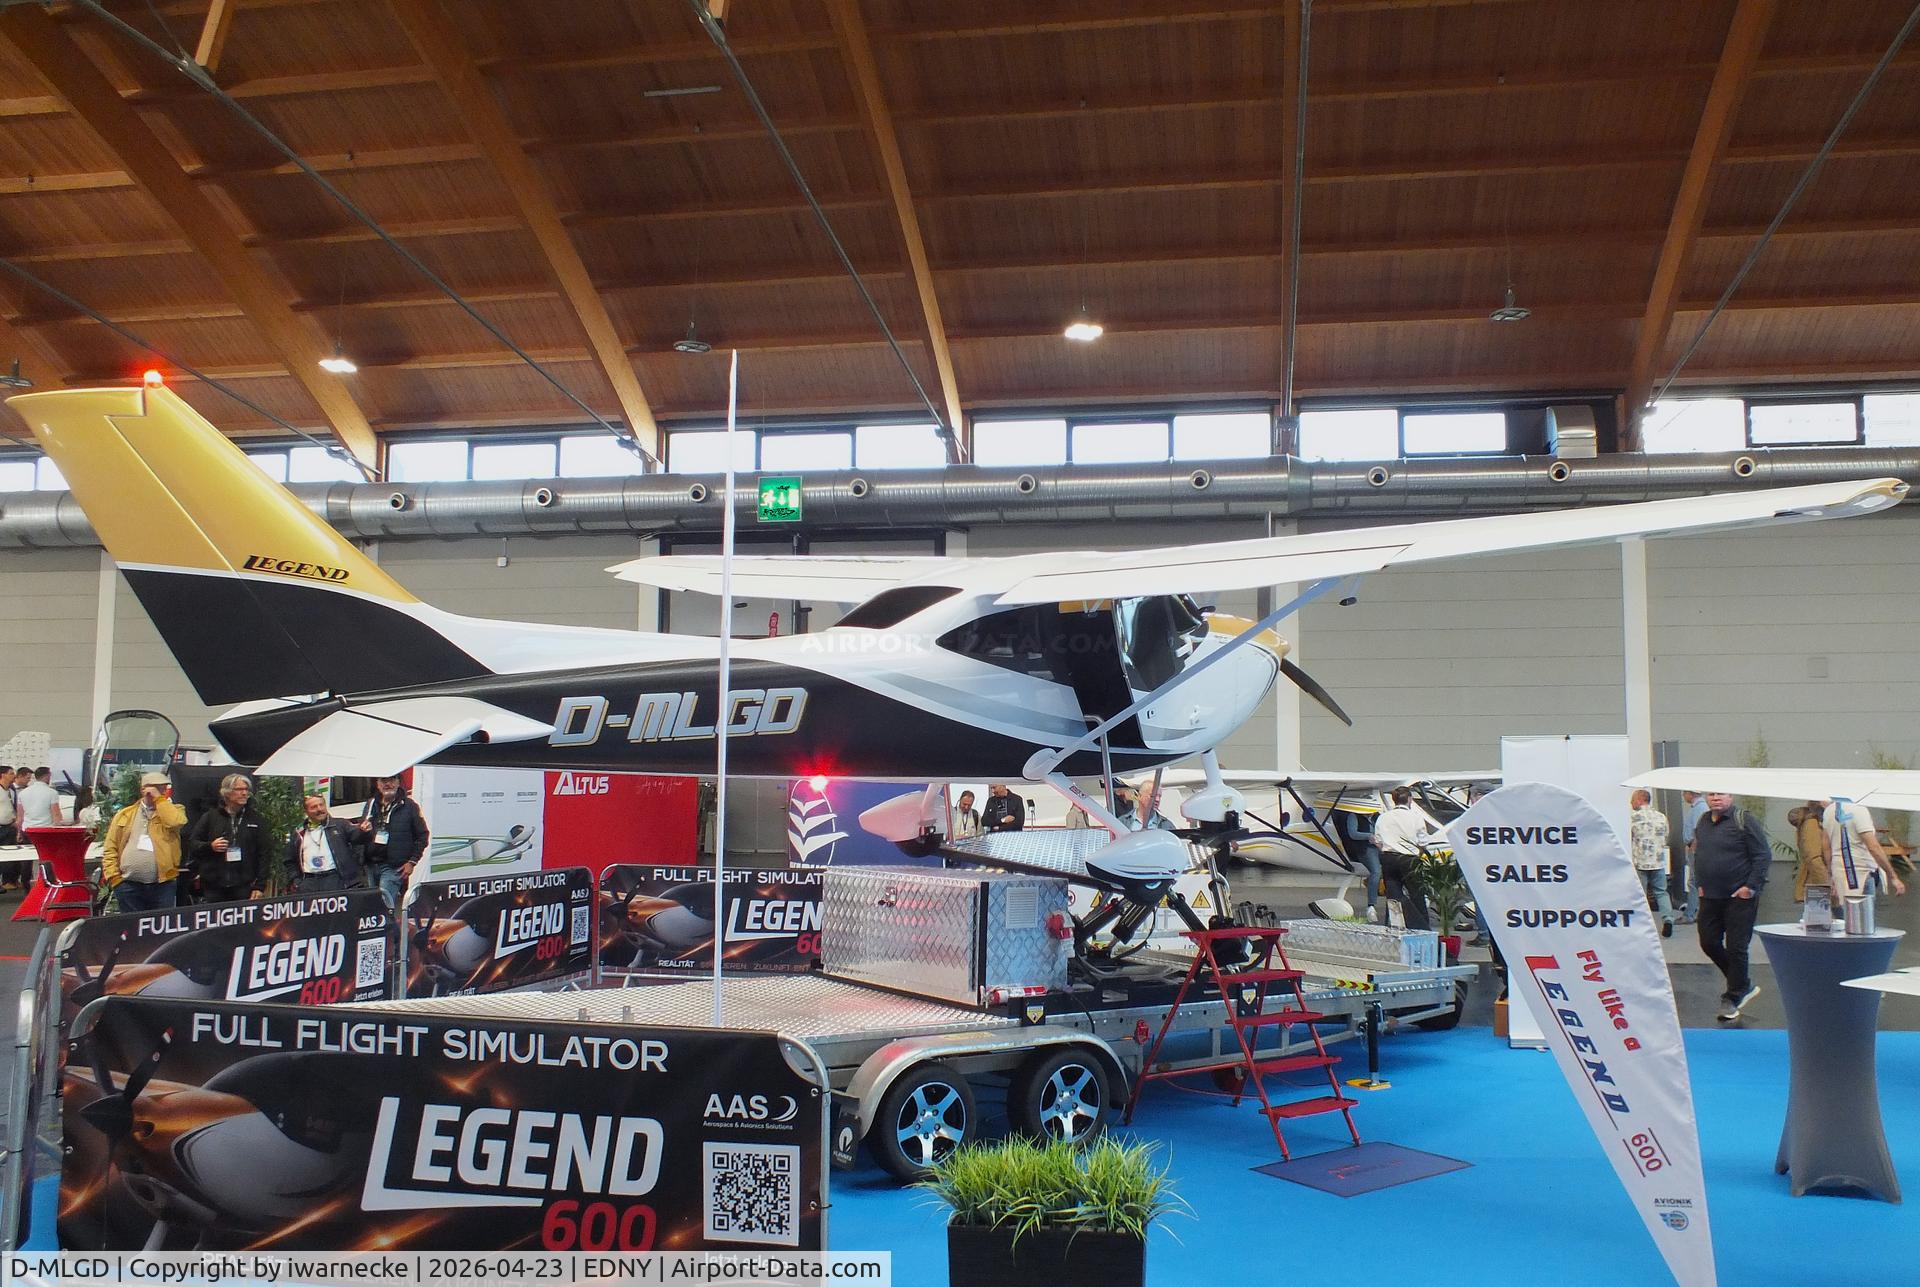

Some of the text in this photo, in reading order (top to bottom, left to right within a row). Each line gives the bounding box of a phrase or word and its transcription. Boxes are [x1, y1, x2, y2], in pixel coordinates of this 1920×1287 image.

[243, 555, 350, 581] LEGEND
[548, 687, 808, 747] D-MLGD
[553, 771, 609, 796] ALTUS
[1466, 826, 1578, 845] SERVICE
[448, 873, 566, 899] FULL FLIGHT SIMULATOR
[654, 869, 823, 885] FULL FLGHT SIMULAT
[1486, 865, 1568, 883] SALES
[138, 896, 348, 936] FULL FLIGHT SIMULATOR
[358, 914, 377, 930] AAS
[724, 898, 824, 942] LEGEN
[1506, 909, 1634, 928] SUPPORT
[494, 902, 565, 959] LEGEND
[796, 933, 822, 954] 60
[536, 936, 564, 960] 600
[225, 933, 346, 1002] LEGEND
[300, 976, 341, 1005] 600
[1576, 949, 1642, 1051] Fly like a
[192, 1012, 669, 1072] FULL FLIGHT SIMULATOR
[1525, 955, 1630, 1114] LEGEND
[703, 1093, 769, 1119] AAS
[703, 1120, 733, 1129] Aerospace
[361, 1097, 664, 1211] LEGEND
[1631, 1133, 1662, 1171] 600
[541, 1200, 657, 1252] 600
